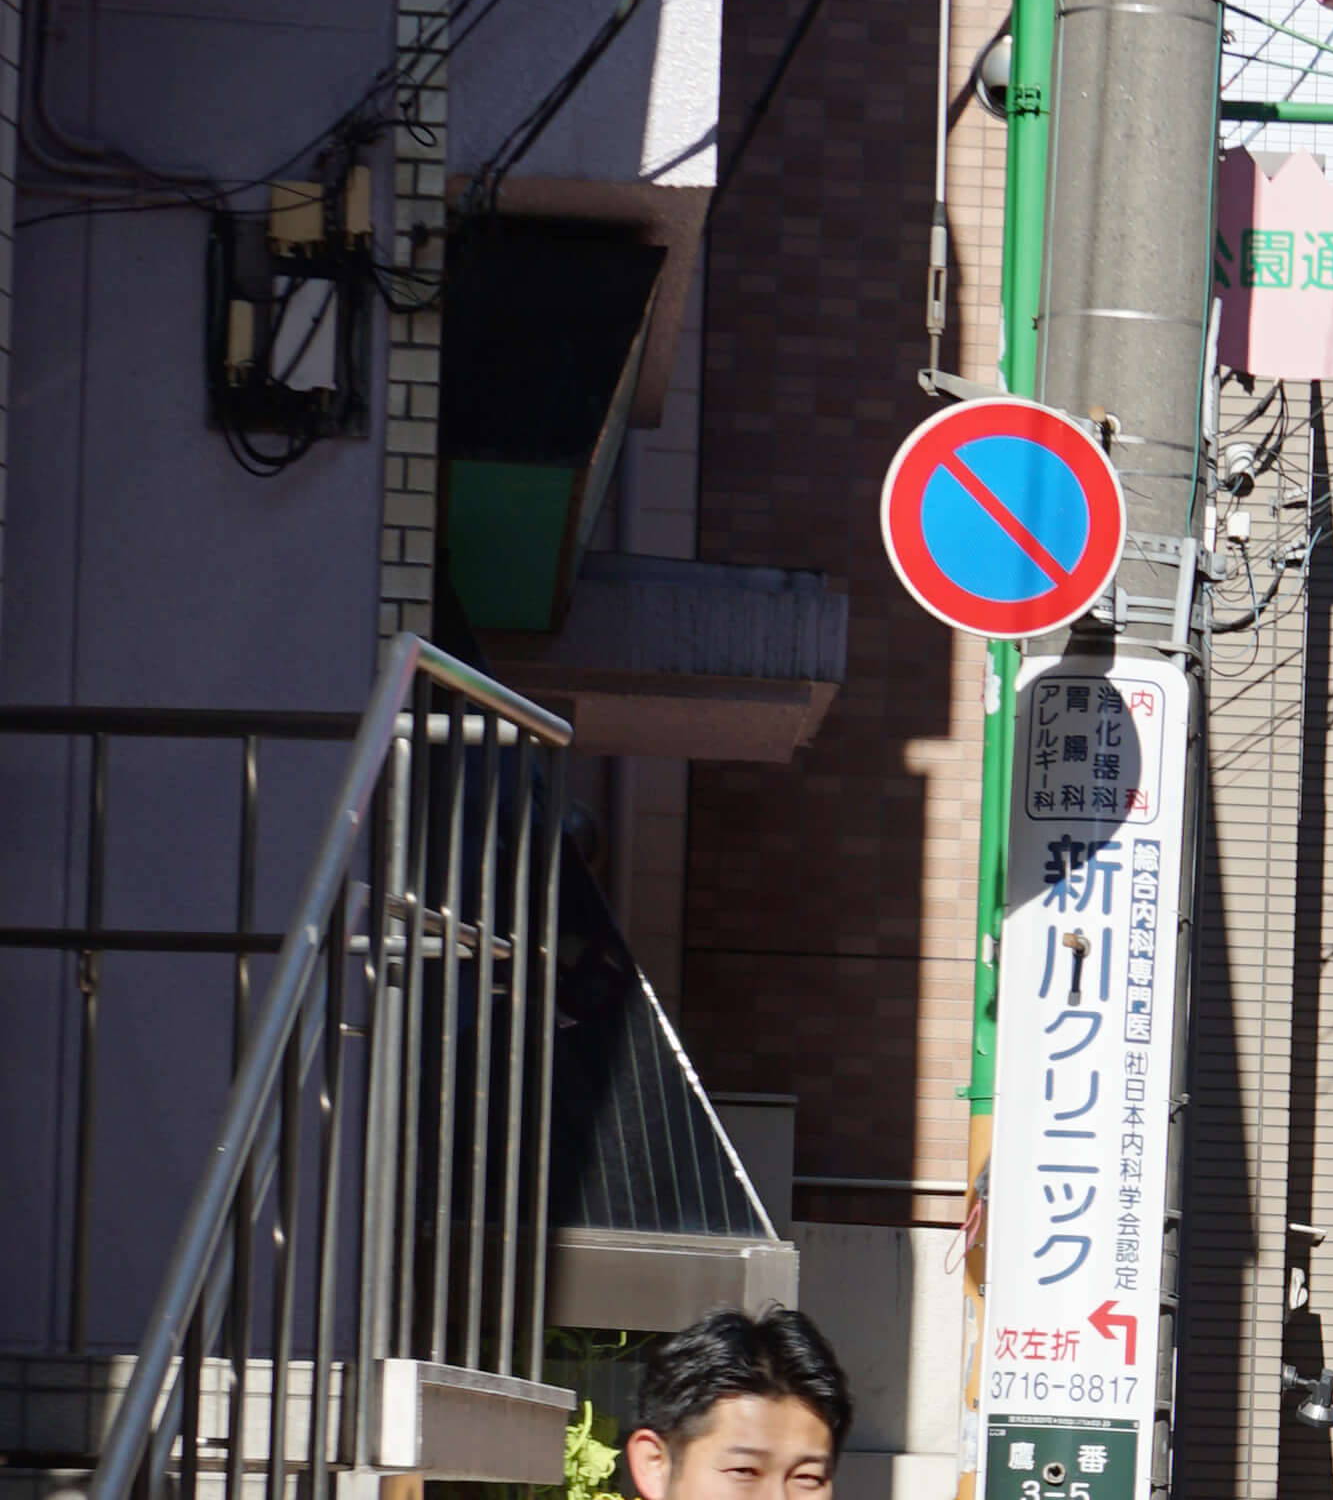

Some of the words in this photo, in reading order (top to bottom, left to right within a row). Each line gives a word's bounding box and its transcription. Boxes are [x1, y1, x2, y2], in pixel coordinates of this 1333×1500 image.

[1033, 683, 1061, 812] アレルギー科
[1060, 685, 1091, 812] 胃腸科
[1091, 686, 1124, 813] 消化器科
[1124, 688, 1156, 817] 内科
[1033, 833, 1124, 1286] 新川クリニック
[990, 1370, 1139, 1406] 3716-8817
[994, 1326, 1081, 1363] 次左折
